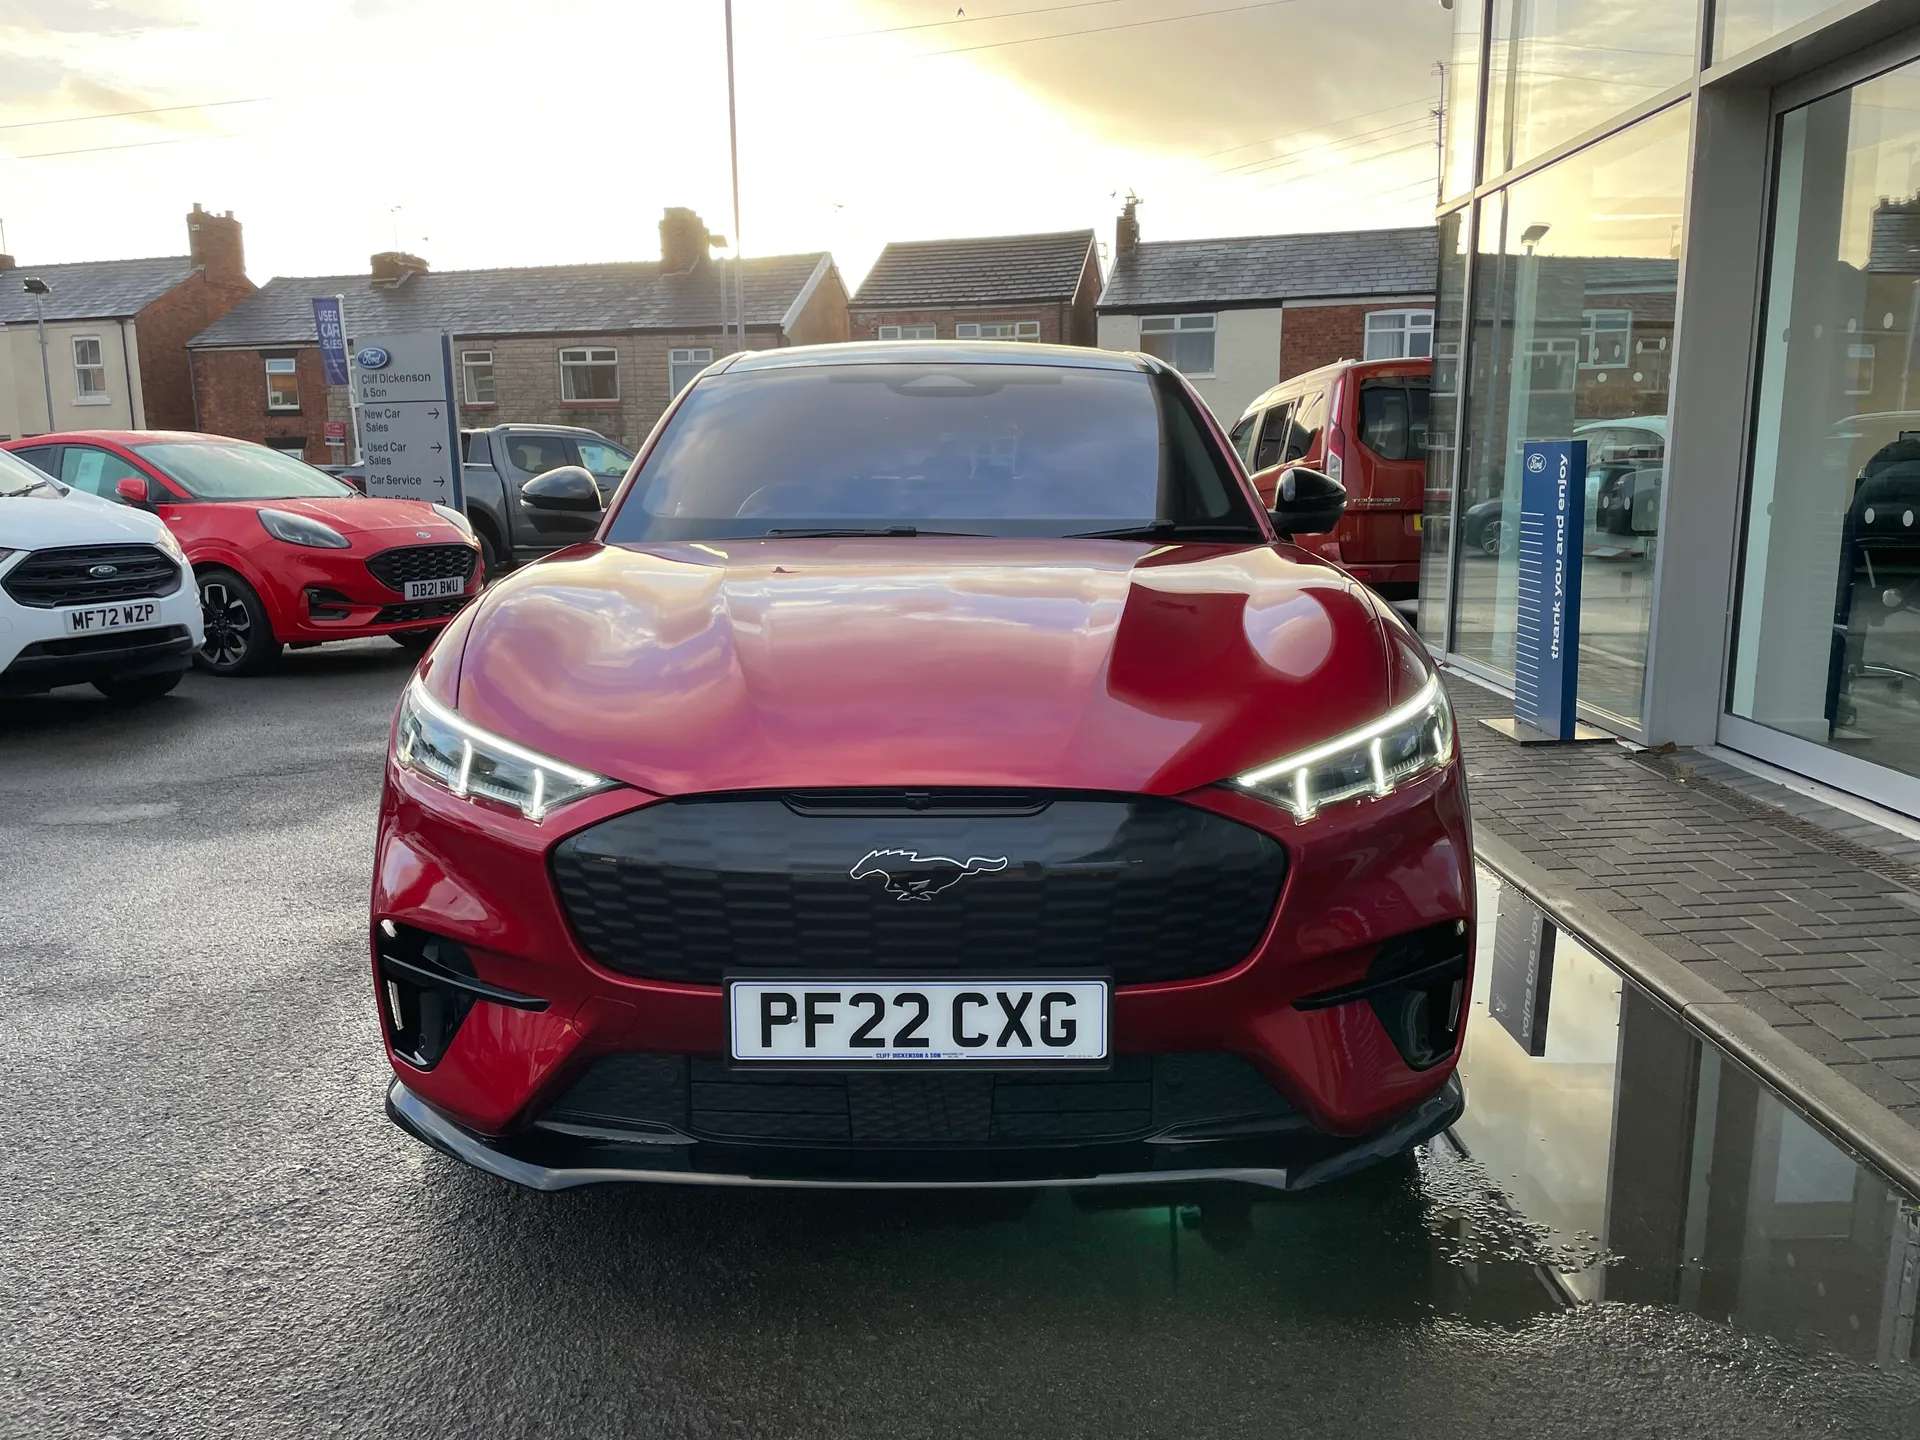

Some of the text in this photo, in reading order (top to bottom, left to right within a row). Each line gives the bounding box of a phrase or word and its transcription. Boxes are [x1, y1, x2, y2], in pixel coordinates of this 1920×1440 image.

[318, 310, 338, 321] USED
[321, 323, 341, 338] CAR
[322, 338, 343, 349] SLES
[362, 350, 381, 364] Ford
[361, 373, 431, 385] Cliff Dickenson
[370, 387, 387, 397] Son
[364, 408, 400, 419] New Car
[365, 422, 389, 432] Sales
[367, 442, 406, 452] Used Car
[368, 456, 392, 465] Sales
[1530, 455, 1544, 470] Ford
[370, 474, 422, 485] Car Service
[1551, 453, 1568, 660] thank you and enjoy
[412, 579, 459, 597] DB21 BWU
[72, 603, 154, 630] MF72 WZP
[760, 992, 1077, 1048] PF22 CXG
